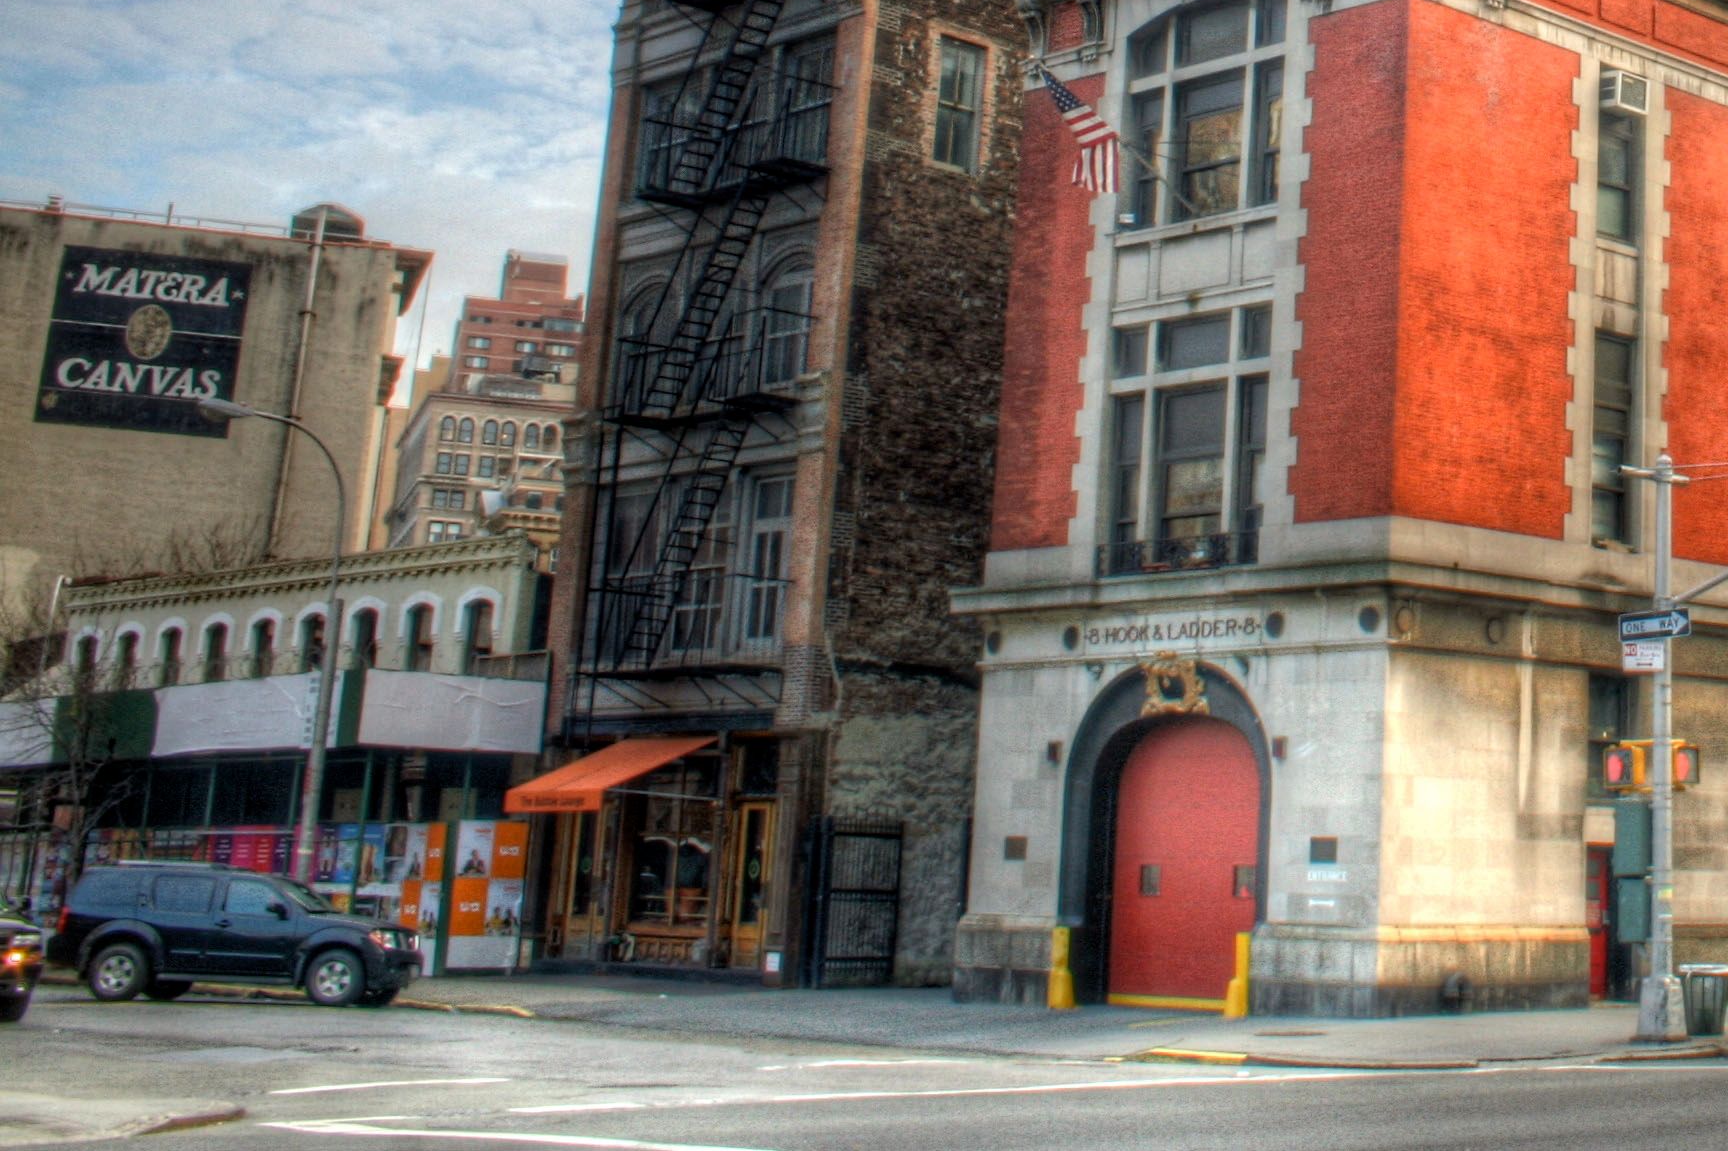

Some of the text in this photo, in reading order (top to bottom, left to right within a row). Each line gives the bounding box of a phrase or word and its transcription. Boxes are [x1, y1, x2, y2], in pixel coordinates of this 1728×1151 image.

[73, 264, 229, 307] MATERA
[57, 358, 221, 398] CANVAS
[1105, 624, 1148, 644] HOOK
[1152, 624, 1163, 641] &
[1167, 618, 1237, 641] LADDER
[1625, 616, 1680, 633] ONE WAY
[1624, 644, 1637, 656] NO
